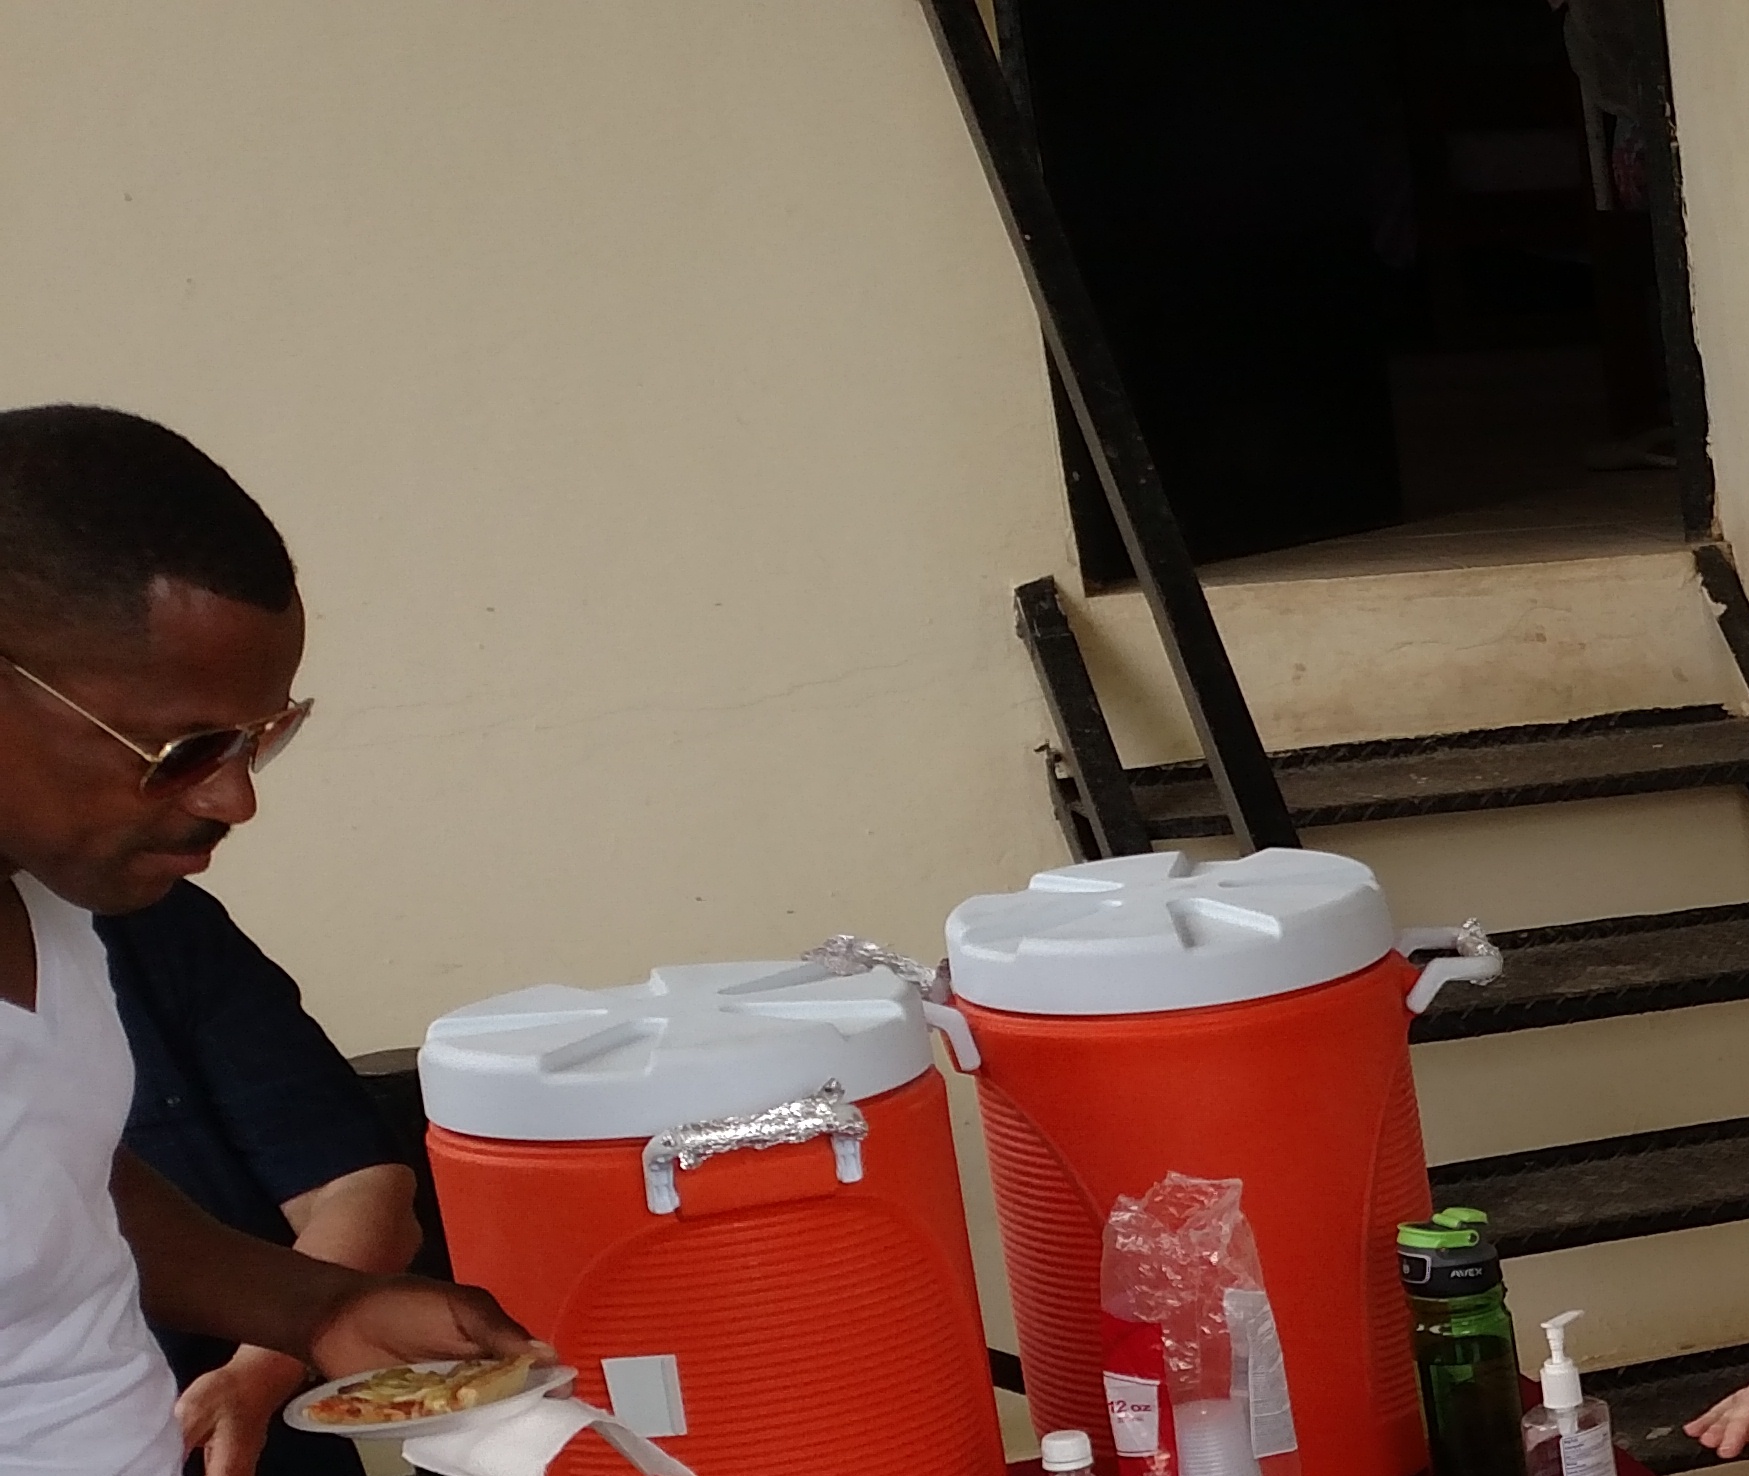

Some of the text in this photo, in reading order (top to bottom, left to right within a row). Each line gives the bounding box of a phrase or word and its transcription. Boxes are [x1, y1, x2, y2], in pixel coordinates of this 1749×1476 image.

[1450, 1268, 1483, 1278] AVEX
[1107, 1400, 1152, 1413] 12 oz
